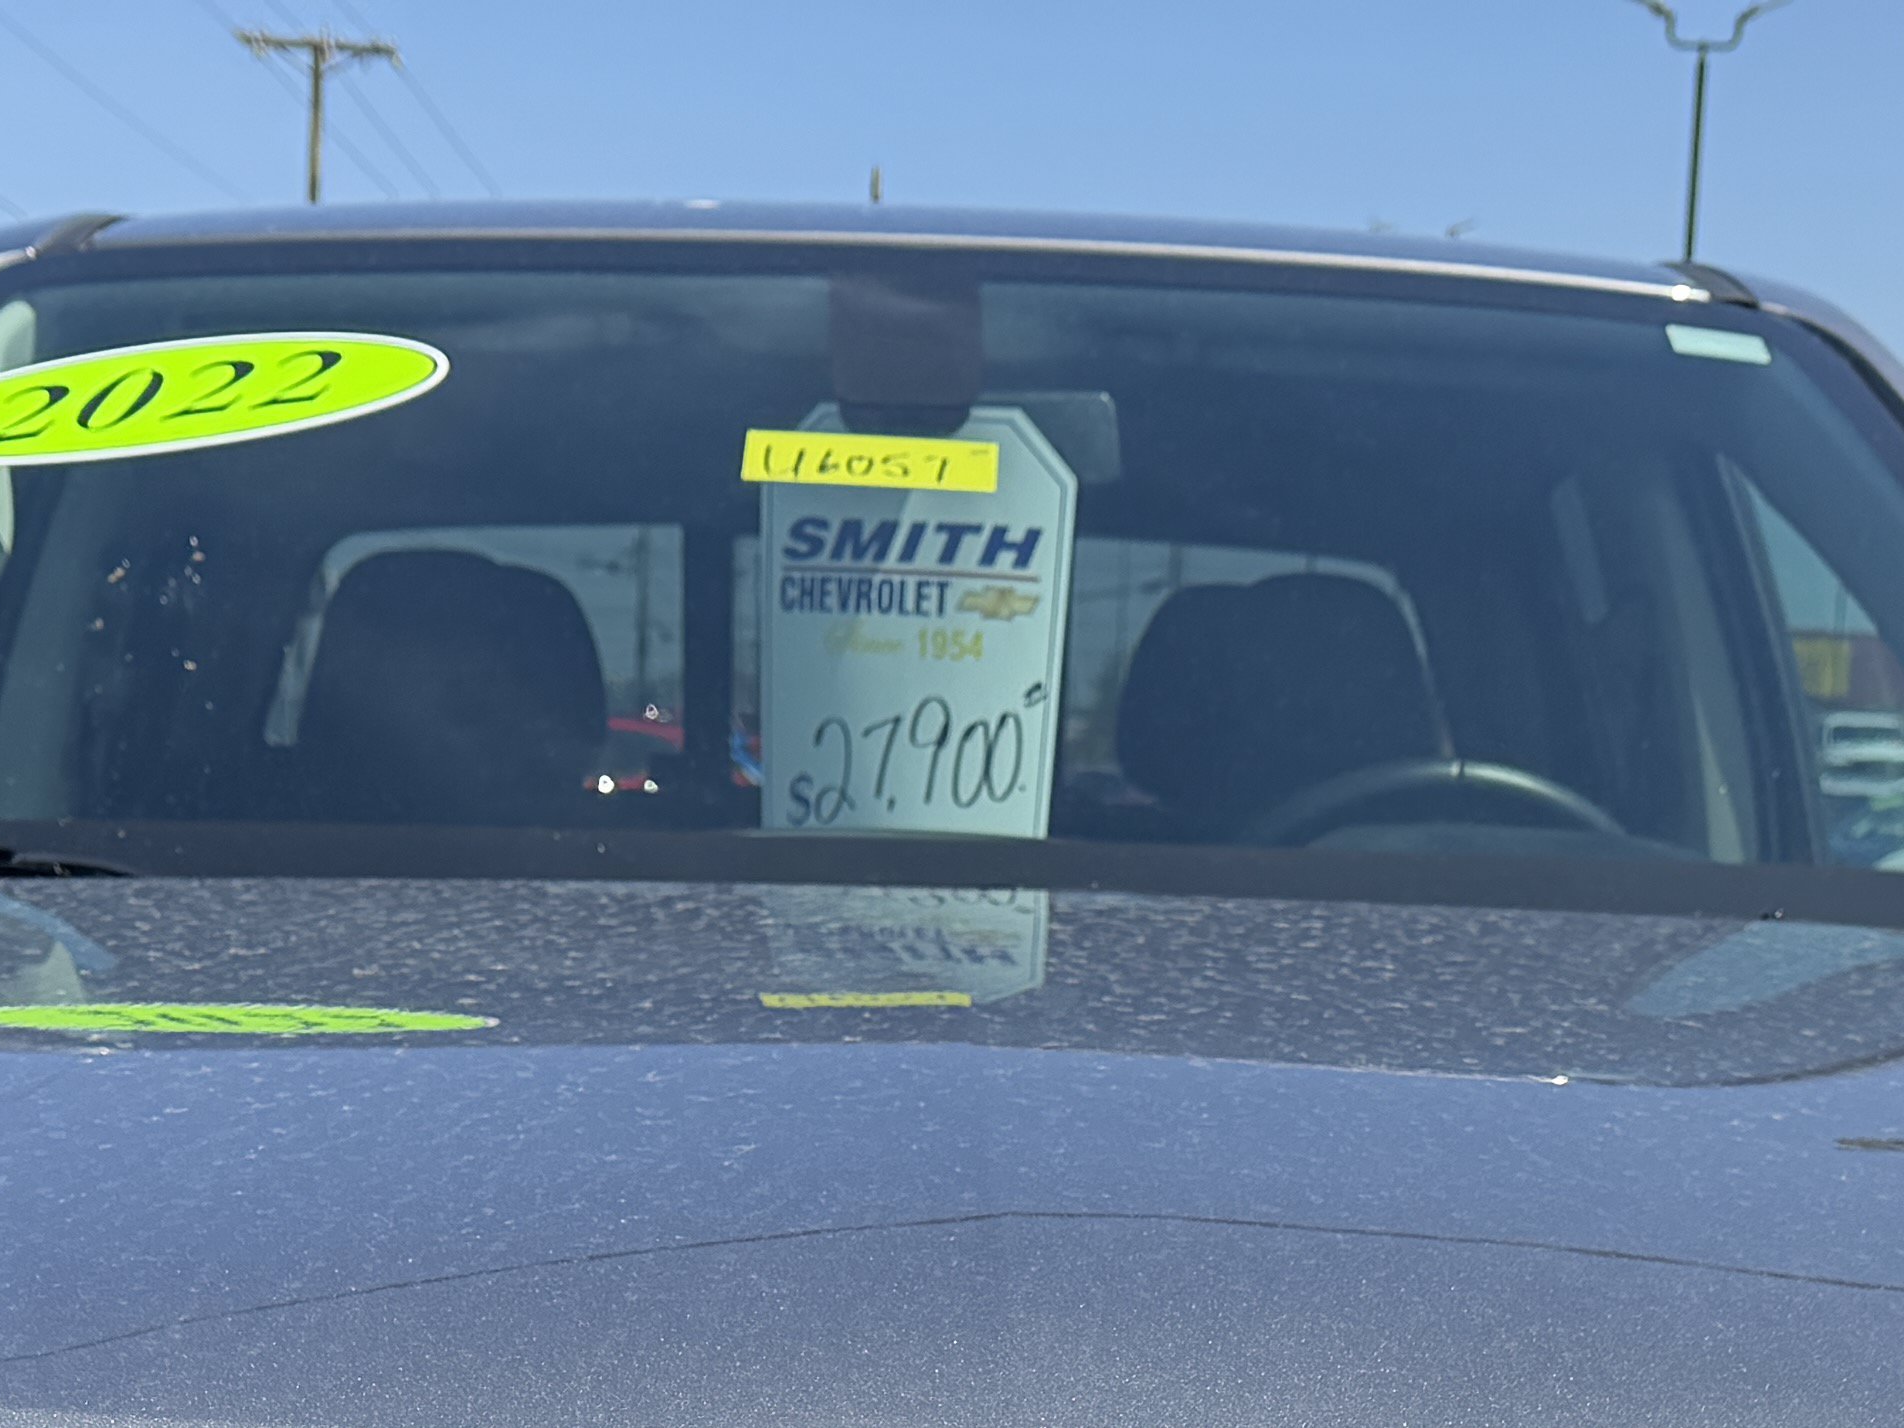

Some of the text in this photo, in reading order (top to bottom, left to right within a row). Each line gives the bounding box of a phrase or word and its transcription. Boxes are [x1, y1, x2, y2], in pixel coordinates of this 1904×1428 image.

[783, 517, 1042, 569] SMITH
[780, 575, 951, 617] CHEVROLET
[917, 627, 985, 662] 1954
